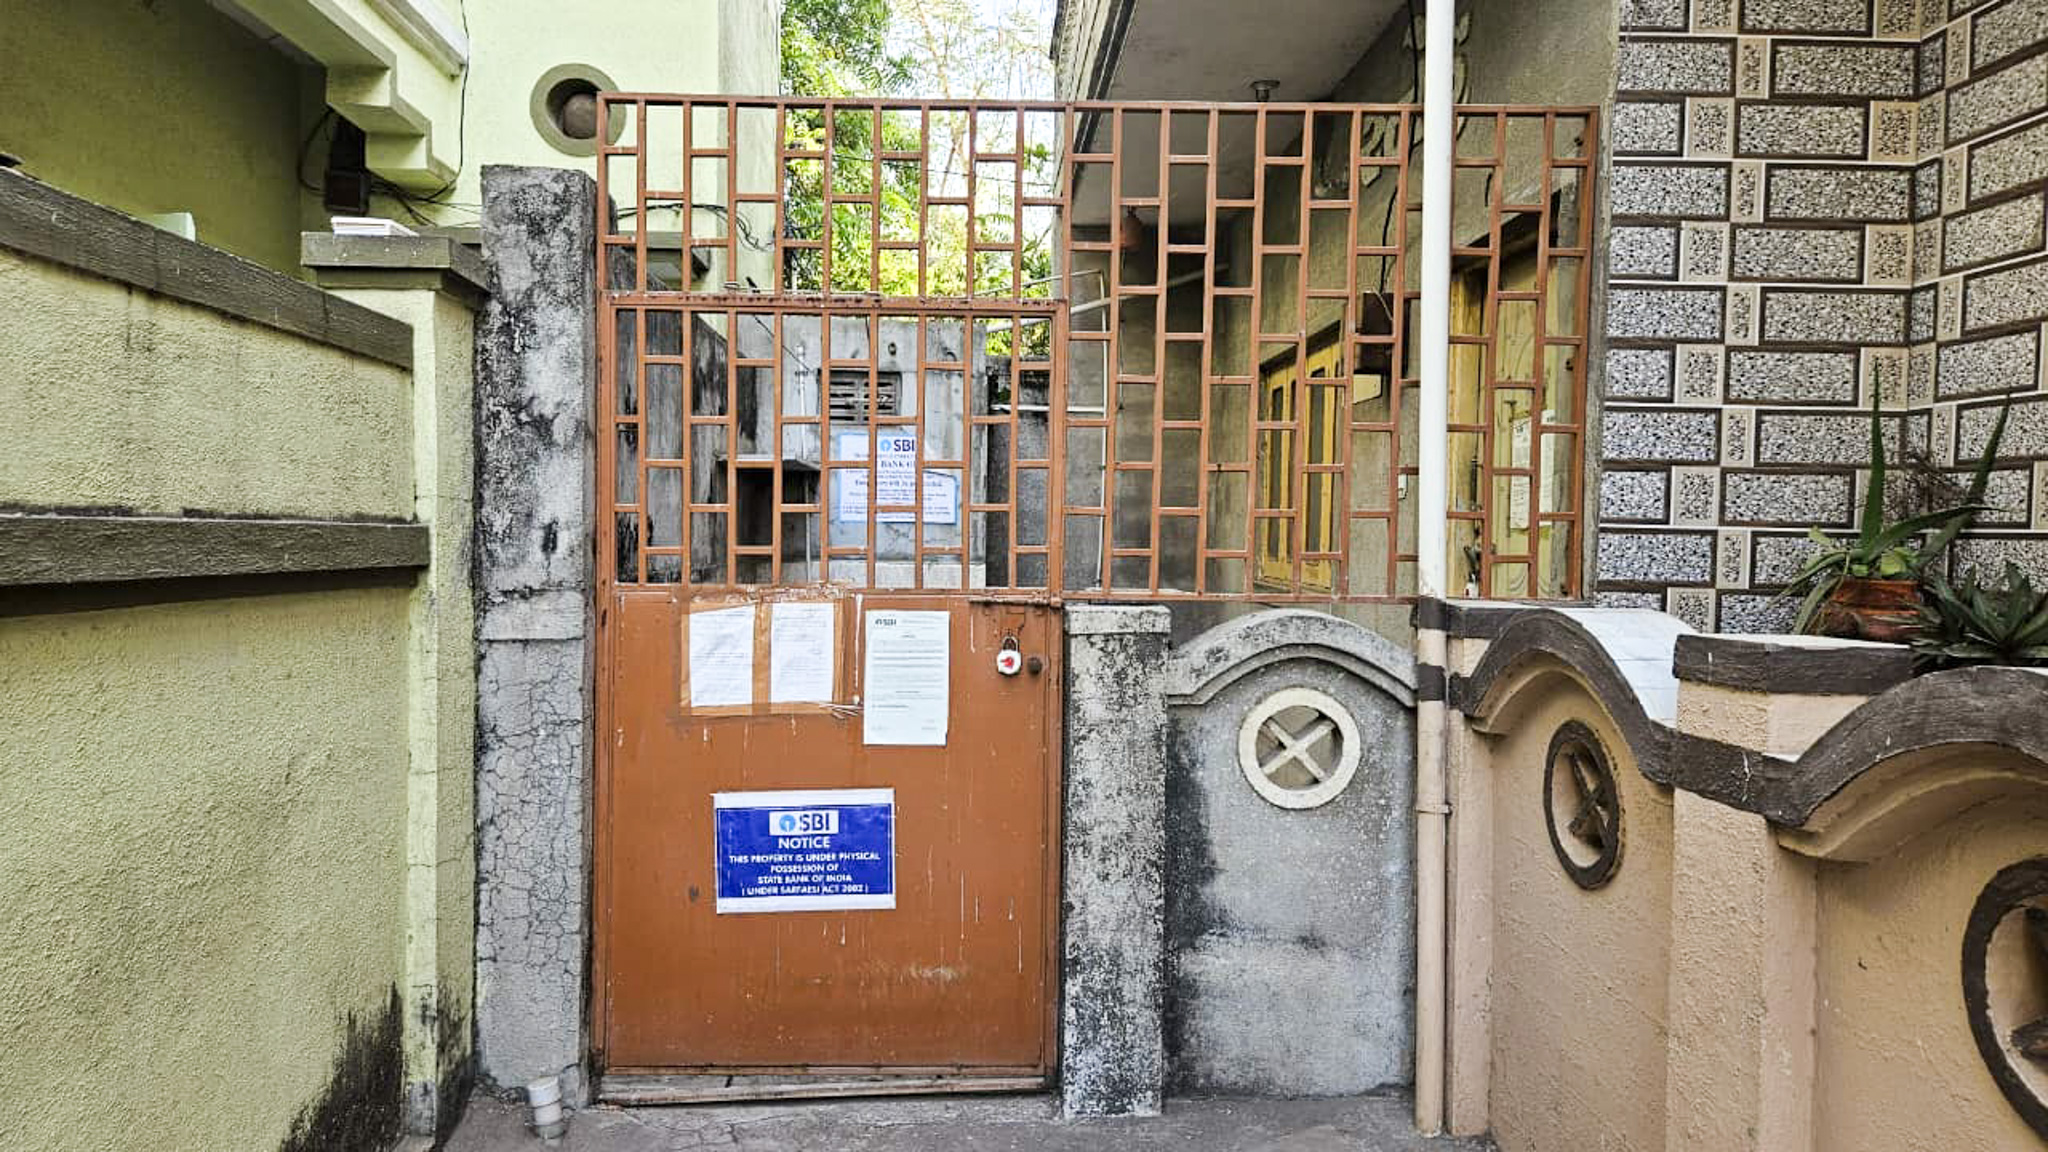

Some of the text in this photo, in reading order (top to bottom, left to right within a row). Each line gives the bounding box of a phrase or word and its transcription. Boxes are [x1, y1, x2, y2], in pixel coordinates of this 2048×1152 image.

[893, 439, 915, 452] SBI
[799, 813, 830, 832] SBI
[778, 837, 831, 849] NOTICE
[729, 852, 881, 863] THIS PROPERTY IS UNDER PHYSICAL
[771, 863, 839, 873] POSSESSION OF
[757, 873, 853, 884] STATE BANK OF INDIA
[747, 886, 778, 896] UNDER
[822, 884, 839, 893] ACT
